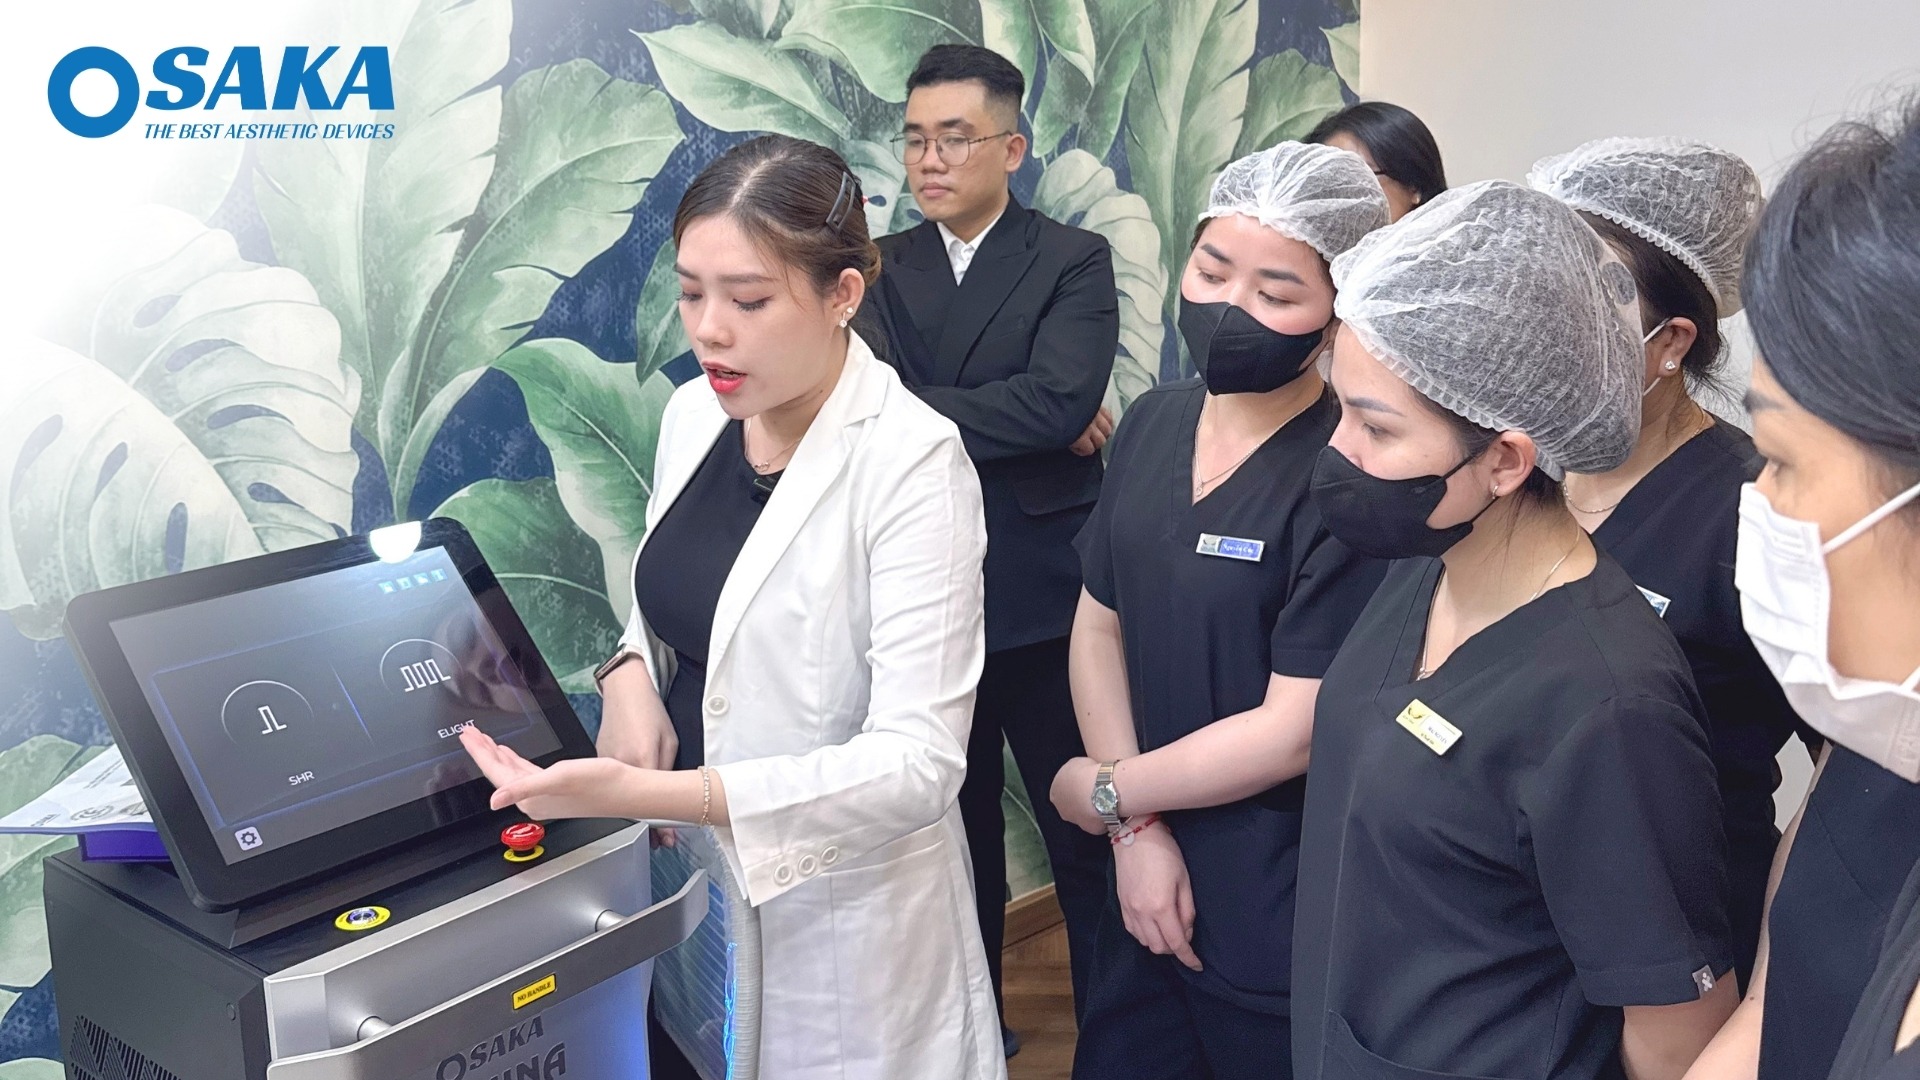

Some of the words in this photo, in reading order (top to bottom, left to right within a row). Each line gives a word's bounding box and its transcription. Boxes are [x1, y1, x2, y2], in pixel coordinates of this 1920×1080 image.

[288, 770, 316, 786] SHR
[517, 994, 527, 1003] NO
[435, 1014, 545, 1080] OSAKA
